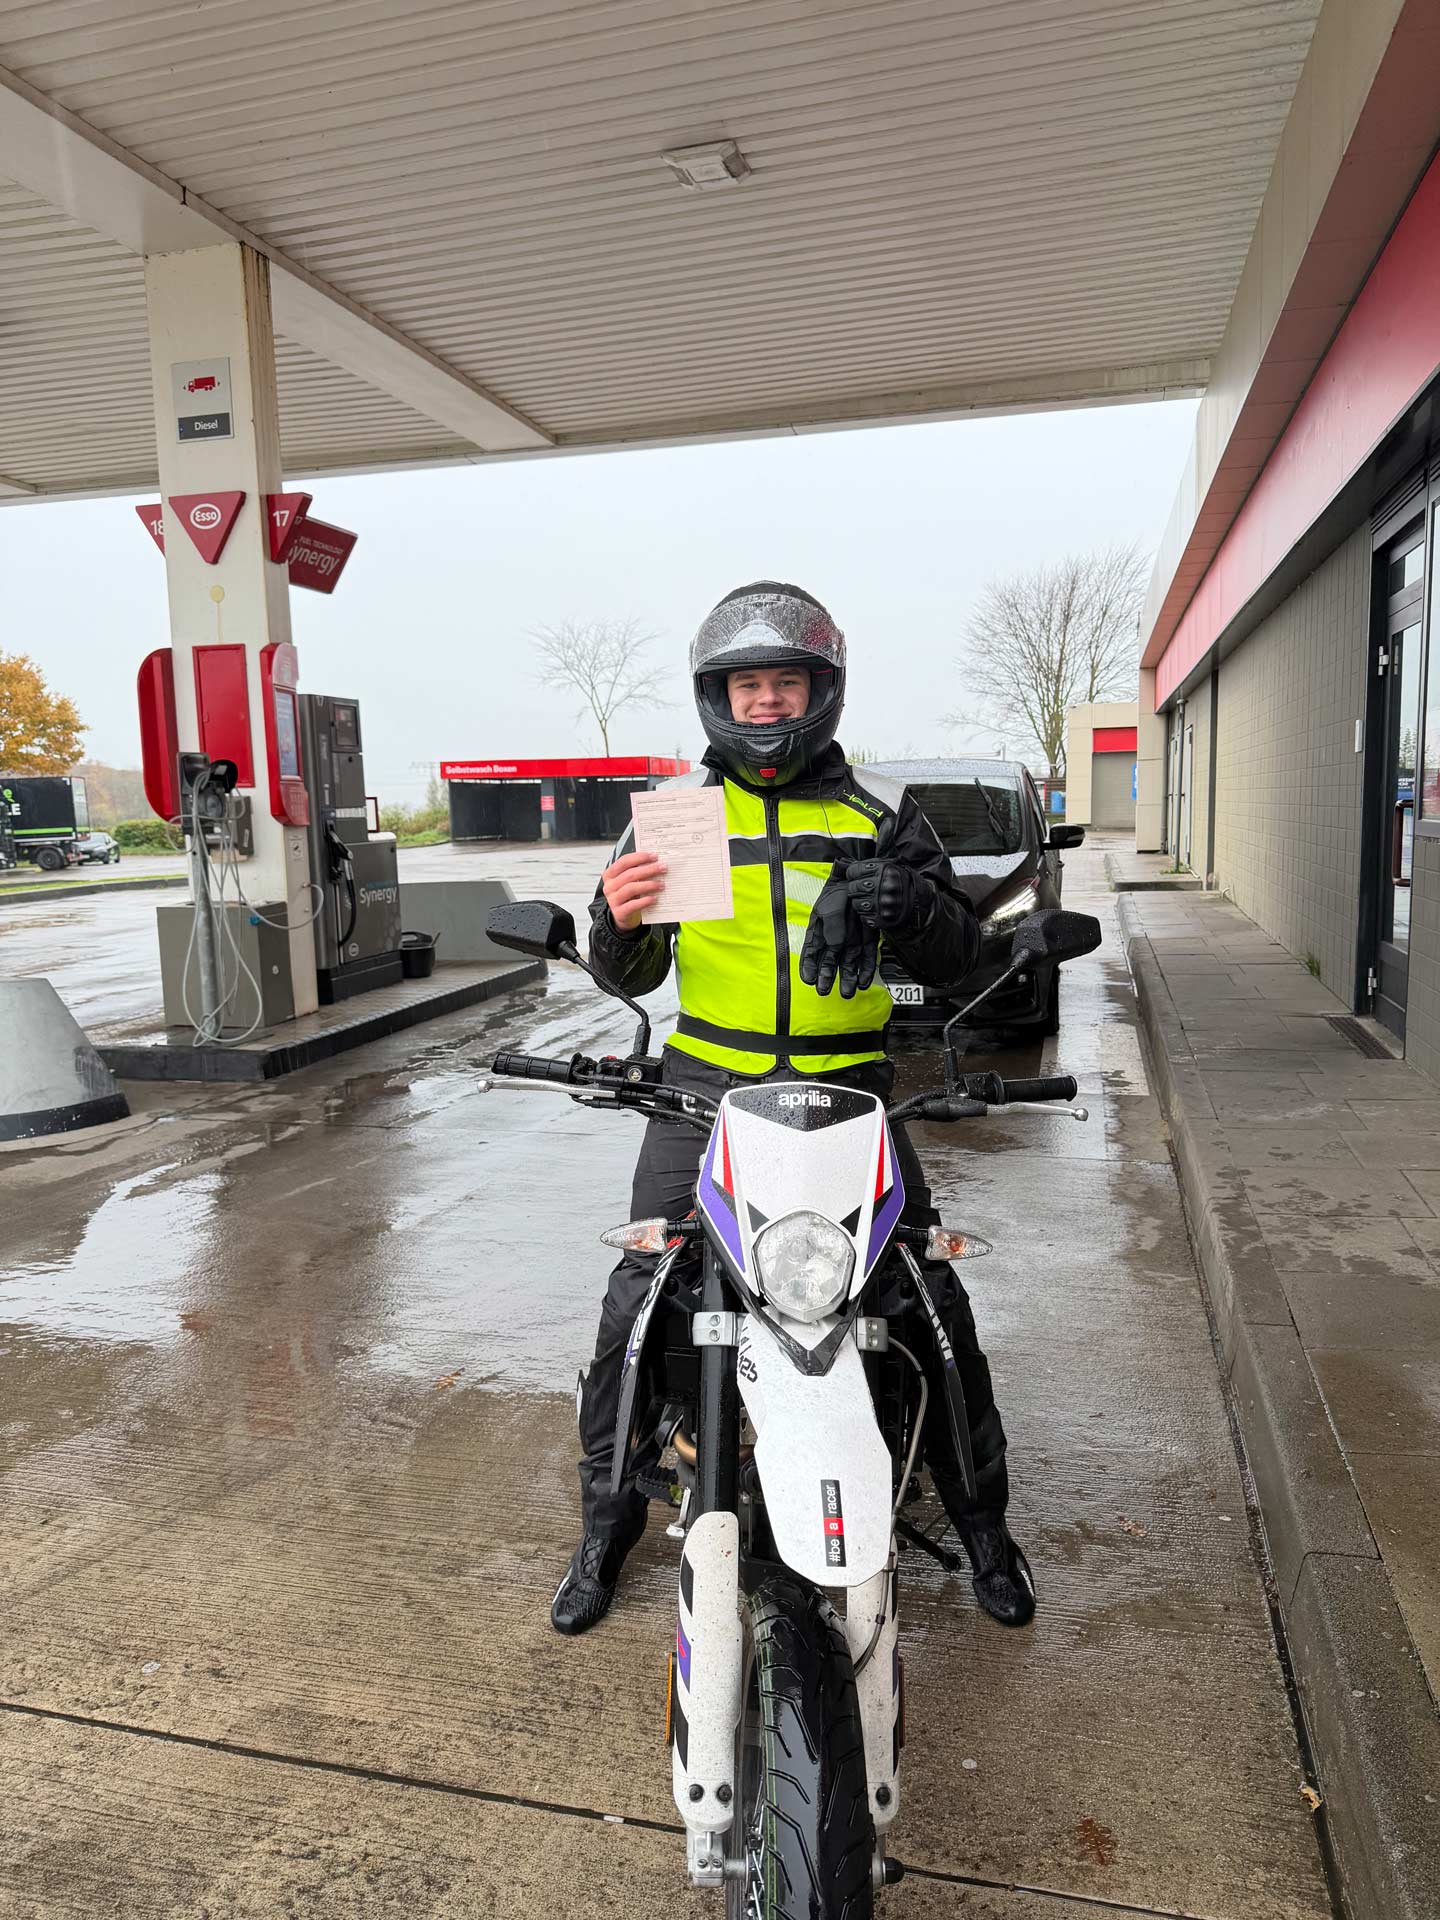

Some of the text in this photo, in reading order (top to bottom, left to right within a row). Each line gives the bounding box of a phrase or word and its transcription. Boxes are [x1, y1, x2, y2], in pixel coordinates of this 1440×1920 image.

[194, 419, 218, 431] Diesel
[194, 510, 217, 522] Esso
[273, 509, 290, 527] 17
[150, 519, 165, 536] 18
[360, 886, 398, 908] Synergy
[895, 986, 922, 1002] 201
[778, 1090, 831, 1109] aprilia
[826, 1484, 841, 1562] #be a racer
